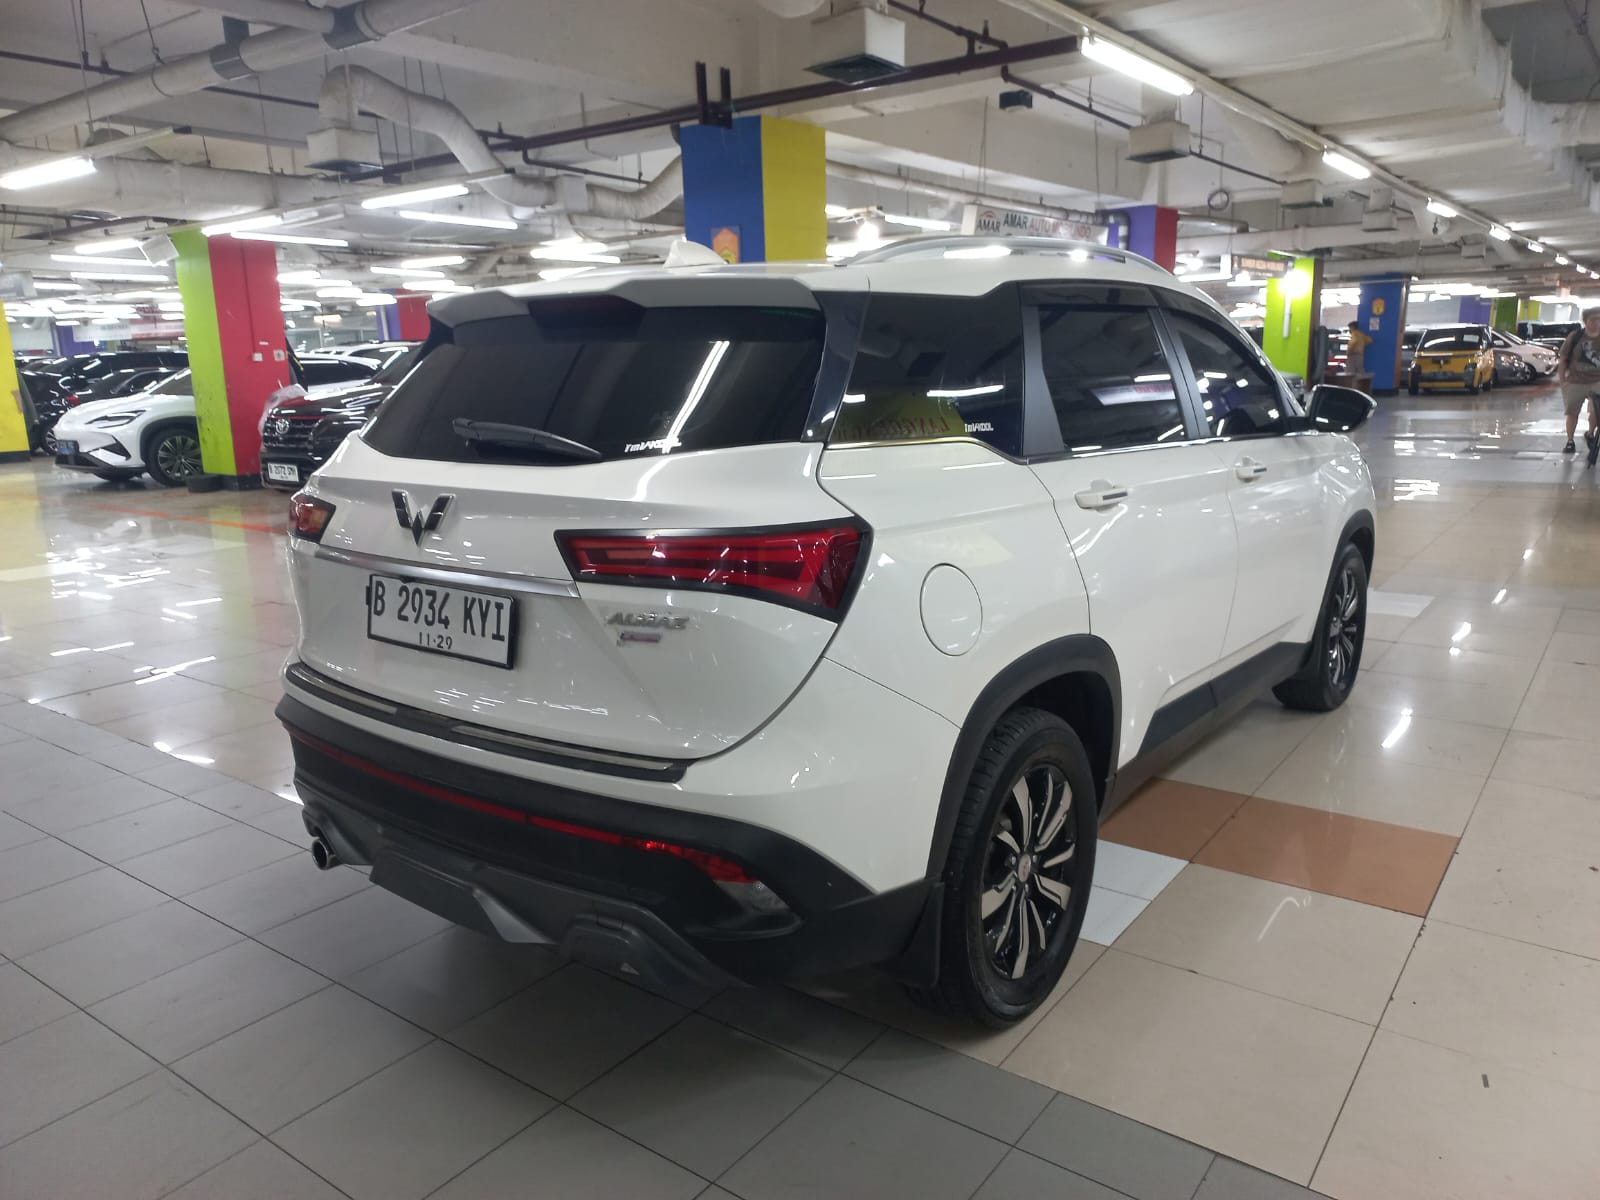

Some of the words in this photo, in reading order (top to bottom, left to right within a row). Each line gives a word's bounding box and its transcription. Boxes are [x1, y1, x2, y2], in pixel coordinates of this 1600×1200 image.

[976, 217, 1000, 232] AMAR
[1002, 213, 1028, 230] AMAR
[1029, 218, 1050, 233] AUTO
[373, 580, 386, 617] B
[397, 585, 450, 630] 2934
[463, 595, 506, 642] KYI
